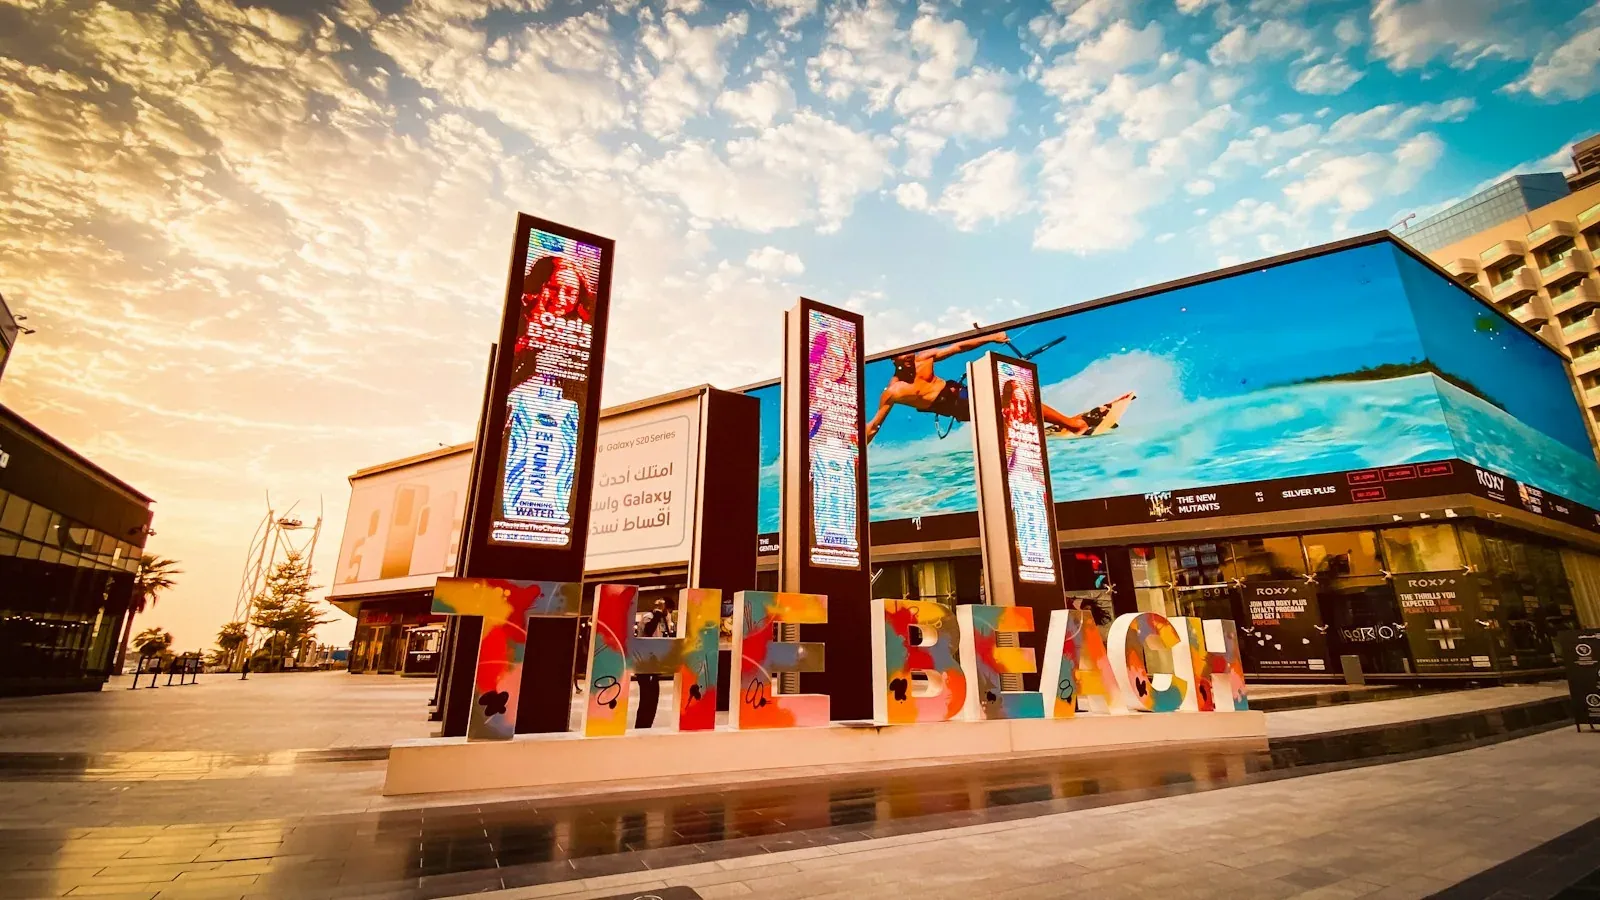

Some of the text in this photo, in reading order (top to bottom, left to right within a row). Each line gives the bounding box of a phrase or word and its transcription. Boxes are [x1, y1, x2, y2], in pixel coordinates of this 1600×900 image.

[540, 312, 592, 332] Oasis
[606, 440, 635, 451] Galaxy
[636, 435, 650, 446] S20
[650, 431, 676, 442] Series
[530, 443, 549, 497] FUNKY
[599, 462, 673, 487] امتلك أحدث
[1476, 469, 1504, 491] ROXY
[623, 490, 672, 507] Galaxy
[1176, 493, 1216, 504] THE NEW
[1282, 486, 1336, 498] SILVER PLUS
[516, 507, 554, 518] WATER
[1179, 503, 1220, 514] MUTANTS
[622, 507, 670, 531] أقساط
[1256, 587, 1289, 596] ROXY
[1408, 579, 1447, 587] ROXY
[1414, 592, 1441, 600] THRILLS
[431, 576, 1249, 742] THE BEACH
